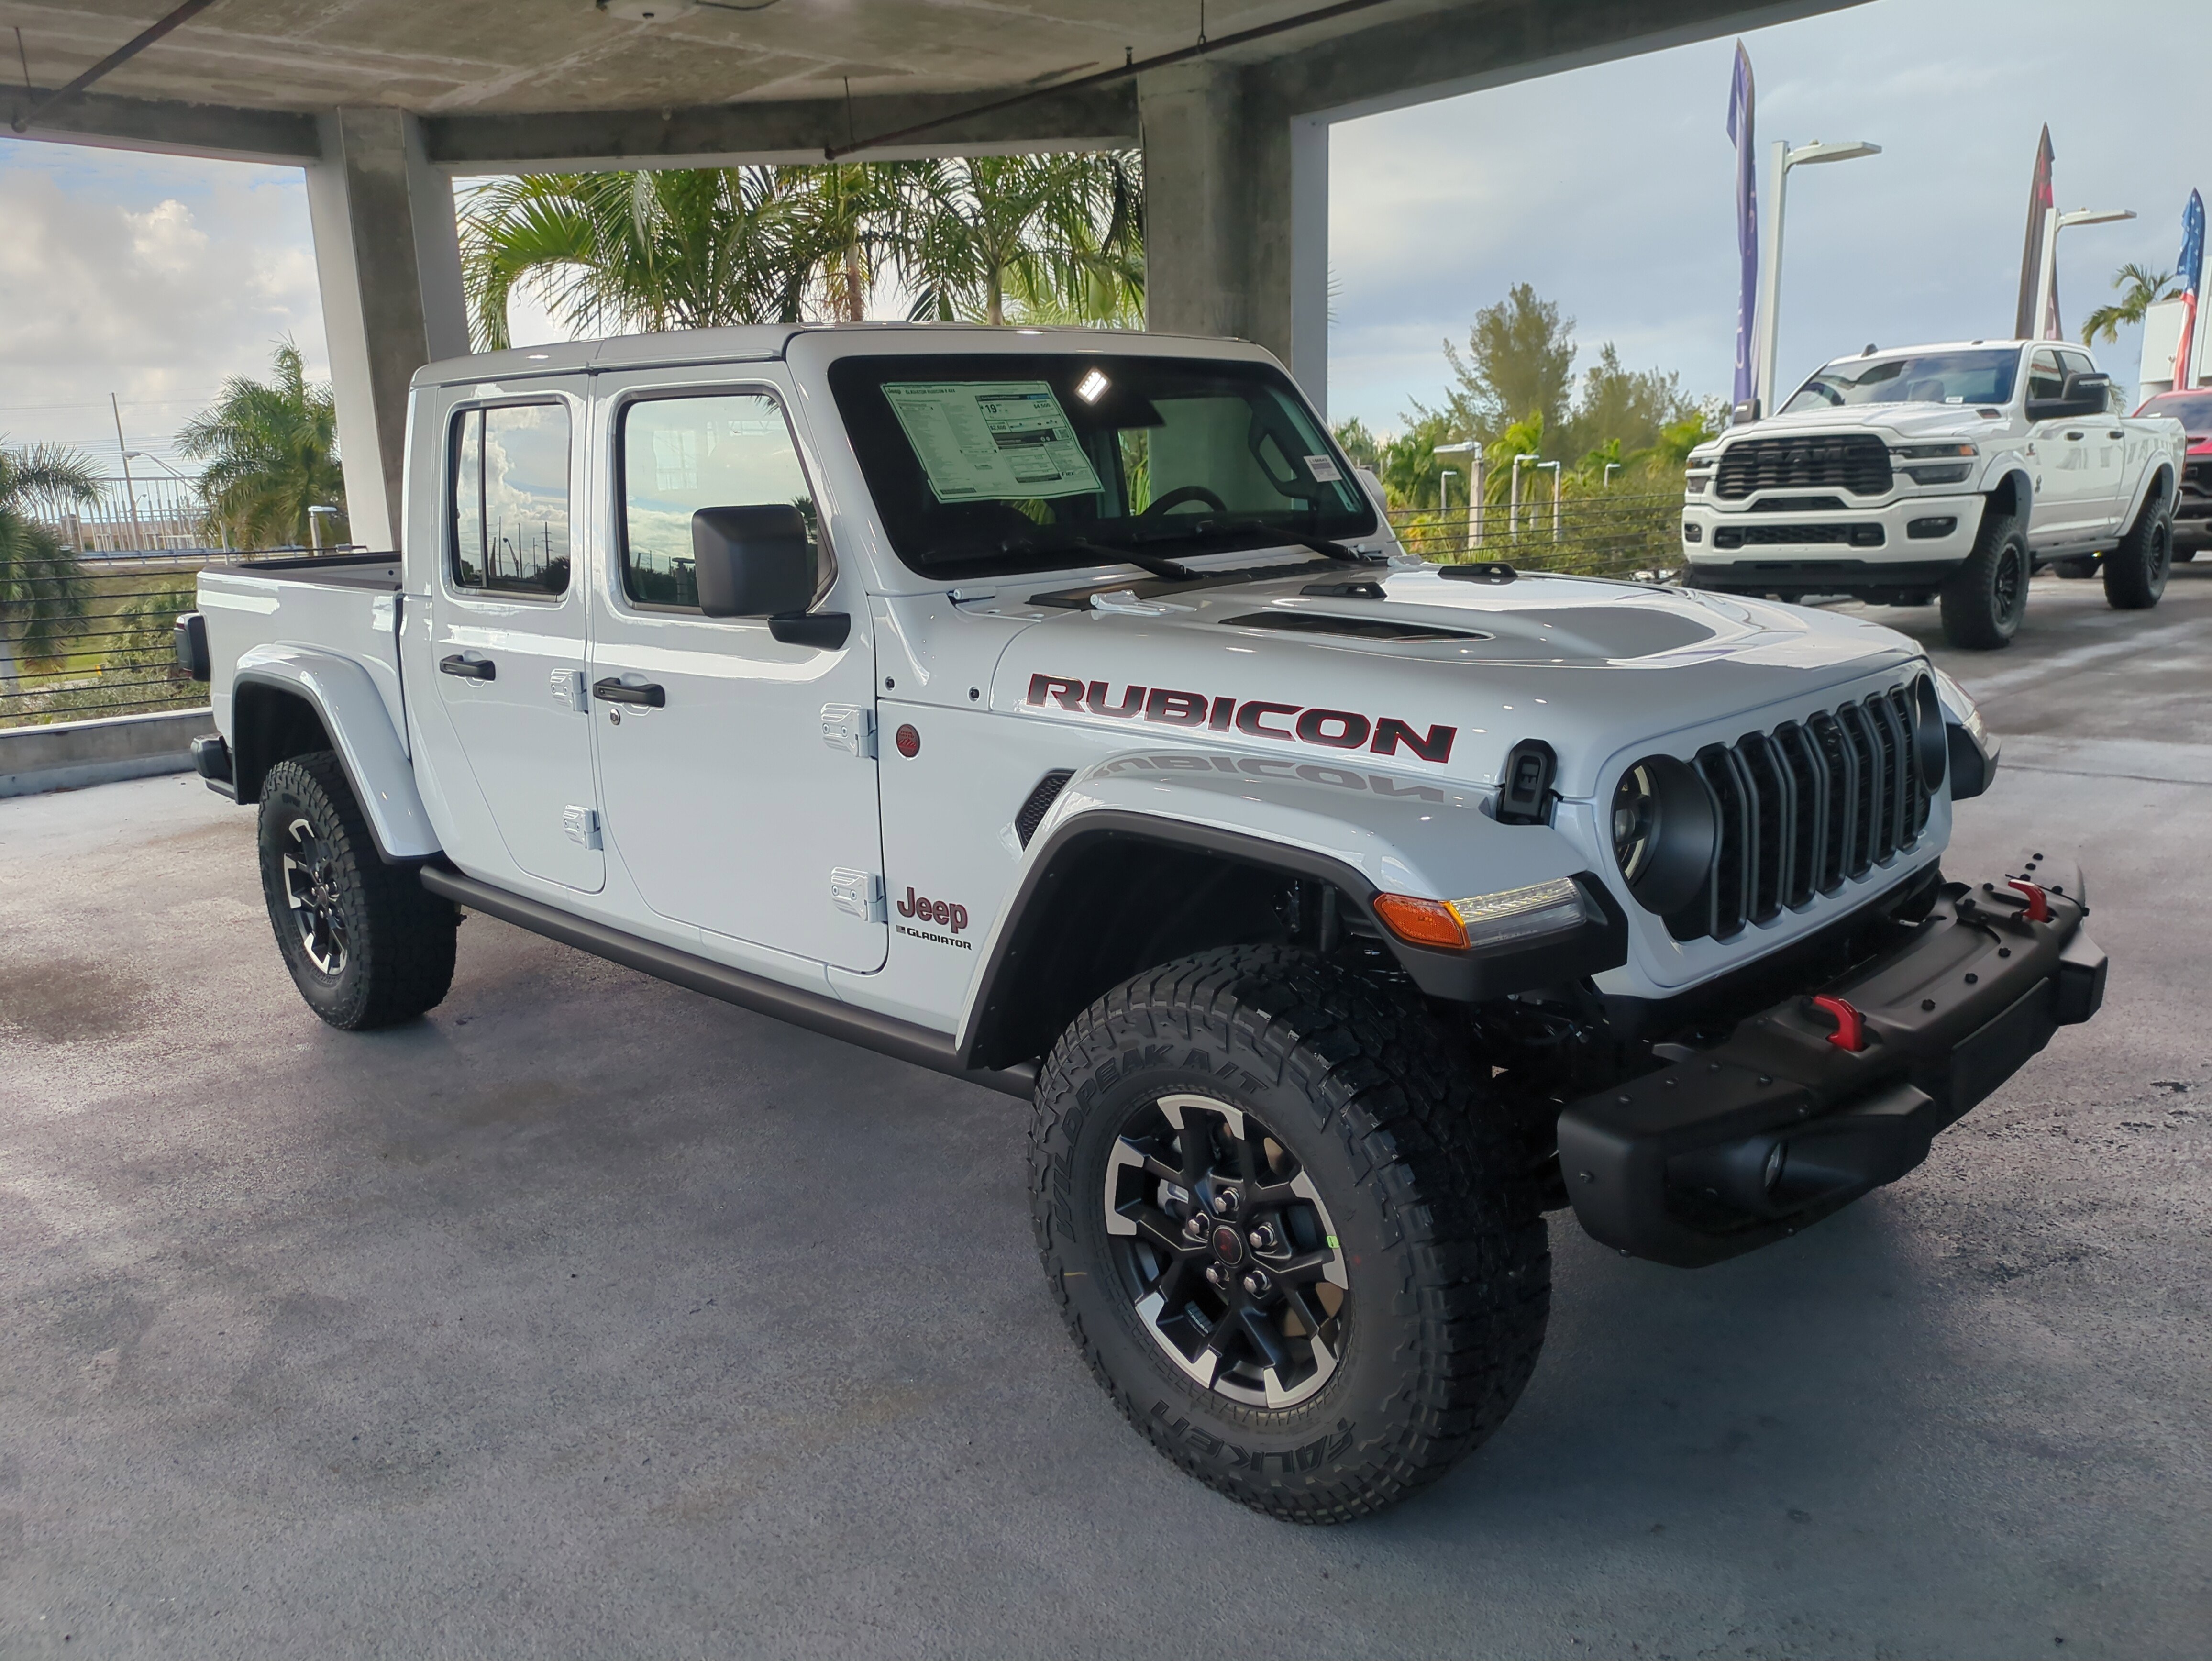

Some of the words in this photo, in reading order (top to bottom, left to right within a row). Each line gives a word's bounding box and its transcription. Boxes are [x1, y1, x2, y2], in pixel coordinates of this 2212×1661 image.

[985, 404, 997, 413] 19
[1758, 446, 1842, 464] RAM
[1026, 673, 1458, 764] RUBICON
[897, 886, 968, 934] Jeep
[907, 928, 972, 951] GLADIATOR
[1150, 1399, 1356, 1474] FALKEN
